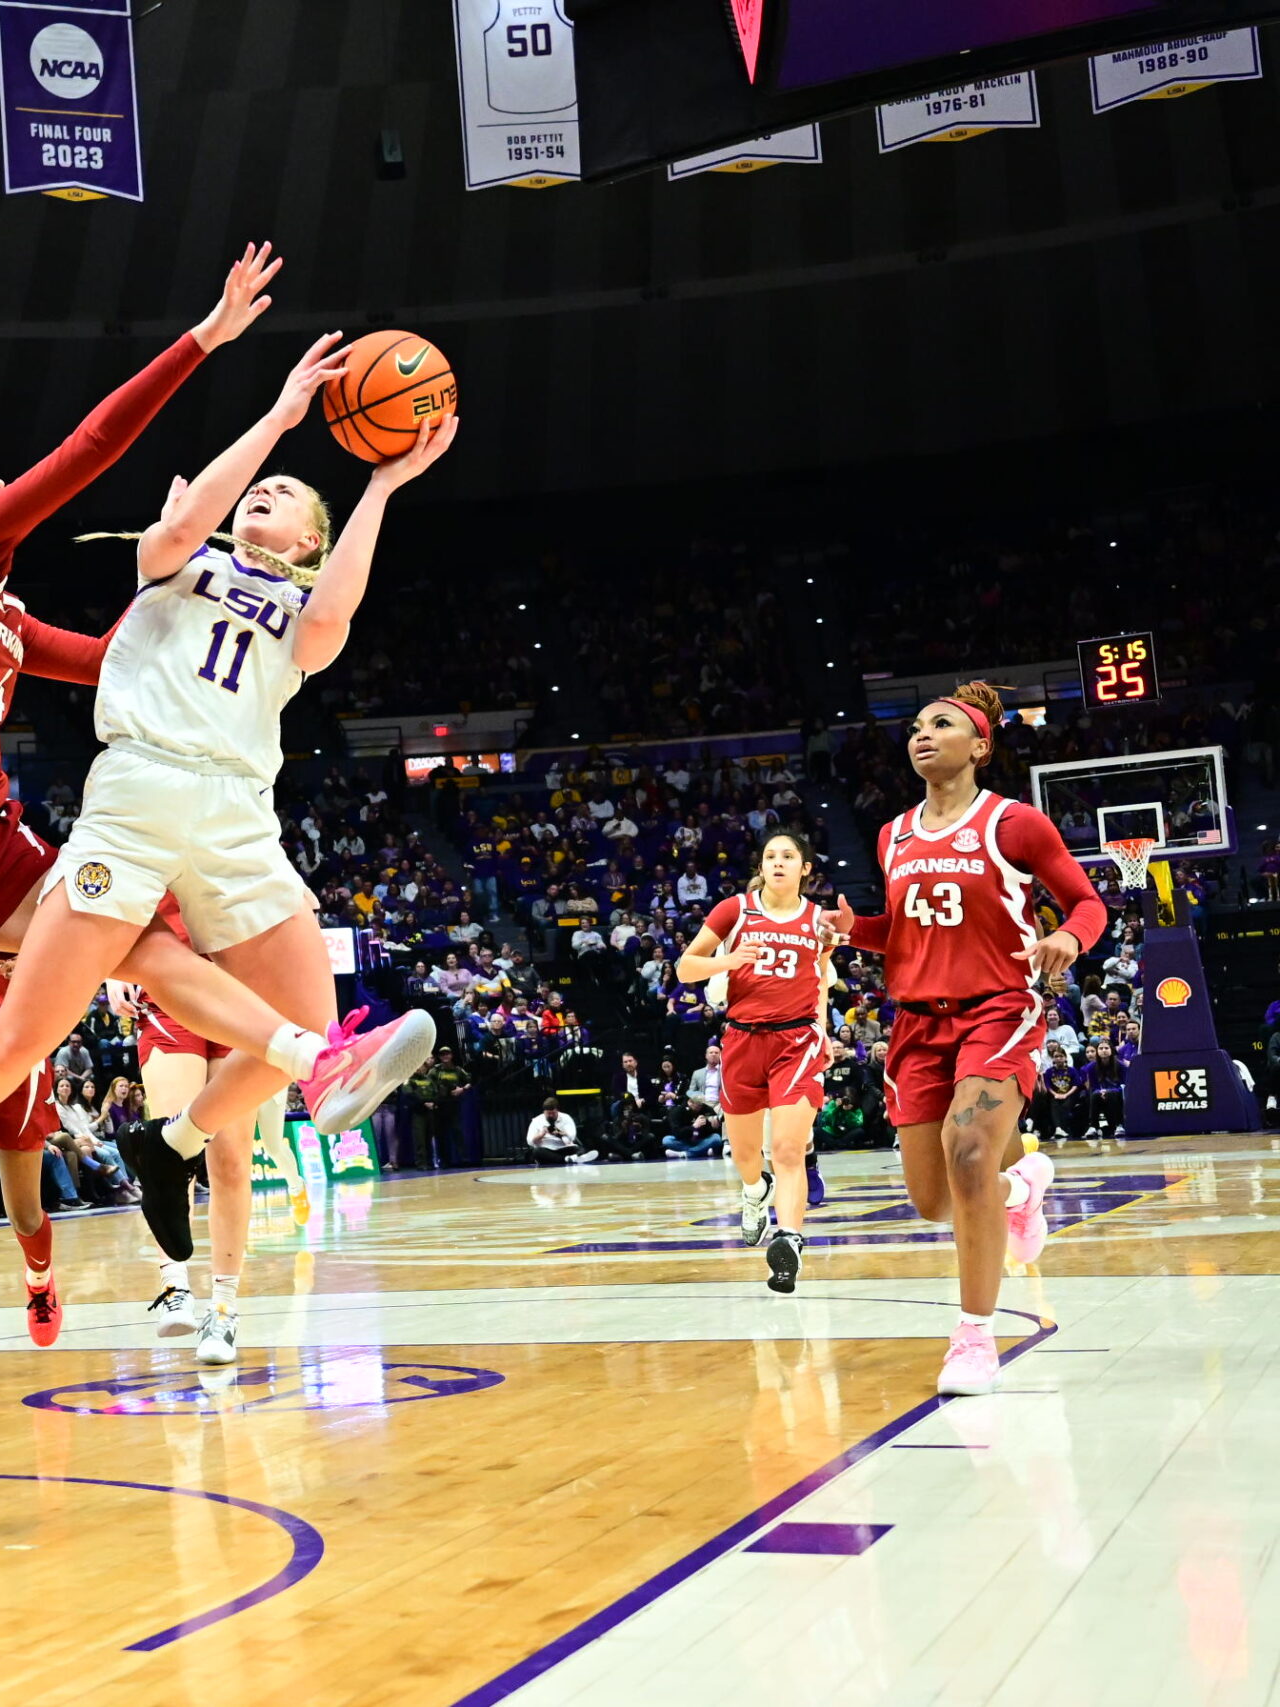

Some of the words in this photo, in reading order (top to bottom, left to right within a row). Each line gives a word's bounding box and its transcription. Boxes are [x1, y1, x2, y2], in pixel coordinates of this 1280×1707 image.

[507, 23, 552, 57] 50
[39, 59, 101, 80] NCAA
[1138, 46, 1208, 74] 1988-90
[974, 75, 1021, 91] MACKLIN
[926, 93, 986, 116] 1976-81
[30, 122, 70, 140] FINAL
[74, 126, 112, 143] FOUR
[507, 136, 527, 145] BOB
[530, 133, 564, 144] PETTIT
[42, 143, 104, 170] 2023
[508, 145, 565, 161] 1951-54
[193, 569, 290, 640] LSU
[197, 619, 255, 694] 11
[1096, 662, 1145, 700] 25
[890, 857, 985, 883] ARKANSAS
[904, 882, 964, 927] 43
[740, 931, 816, 950] ARKANSAS
[754, 947, 798, 979] 23
[1154, 1069, 1208, 1100] H&E
[1157, 1101, 1208, 1111] RENTALS
